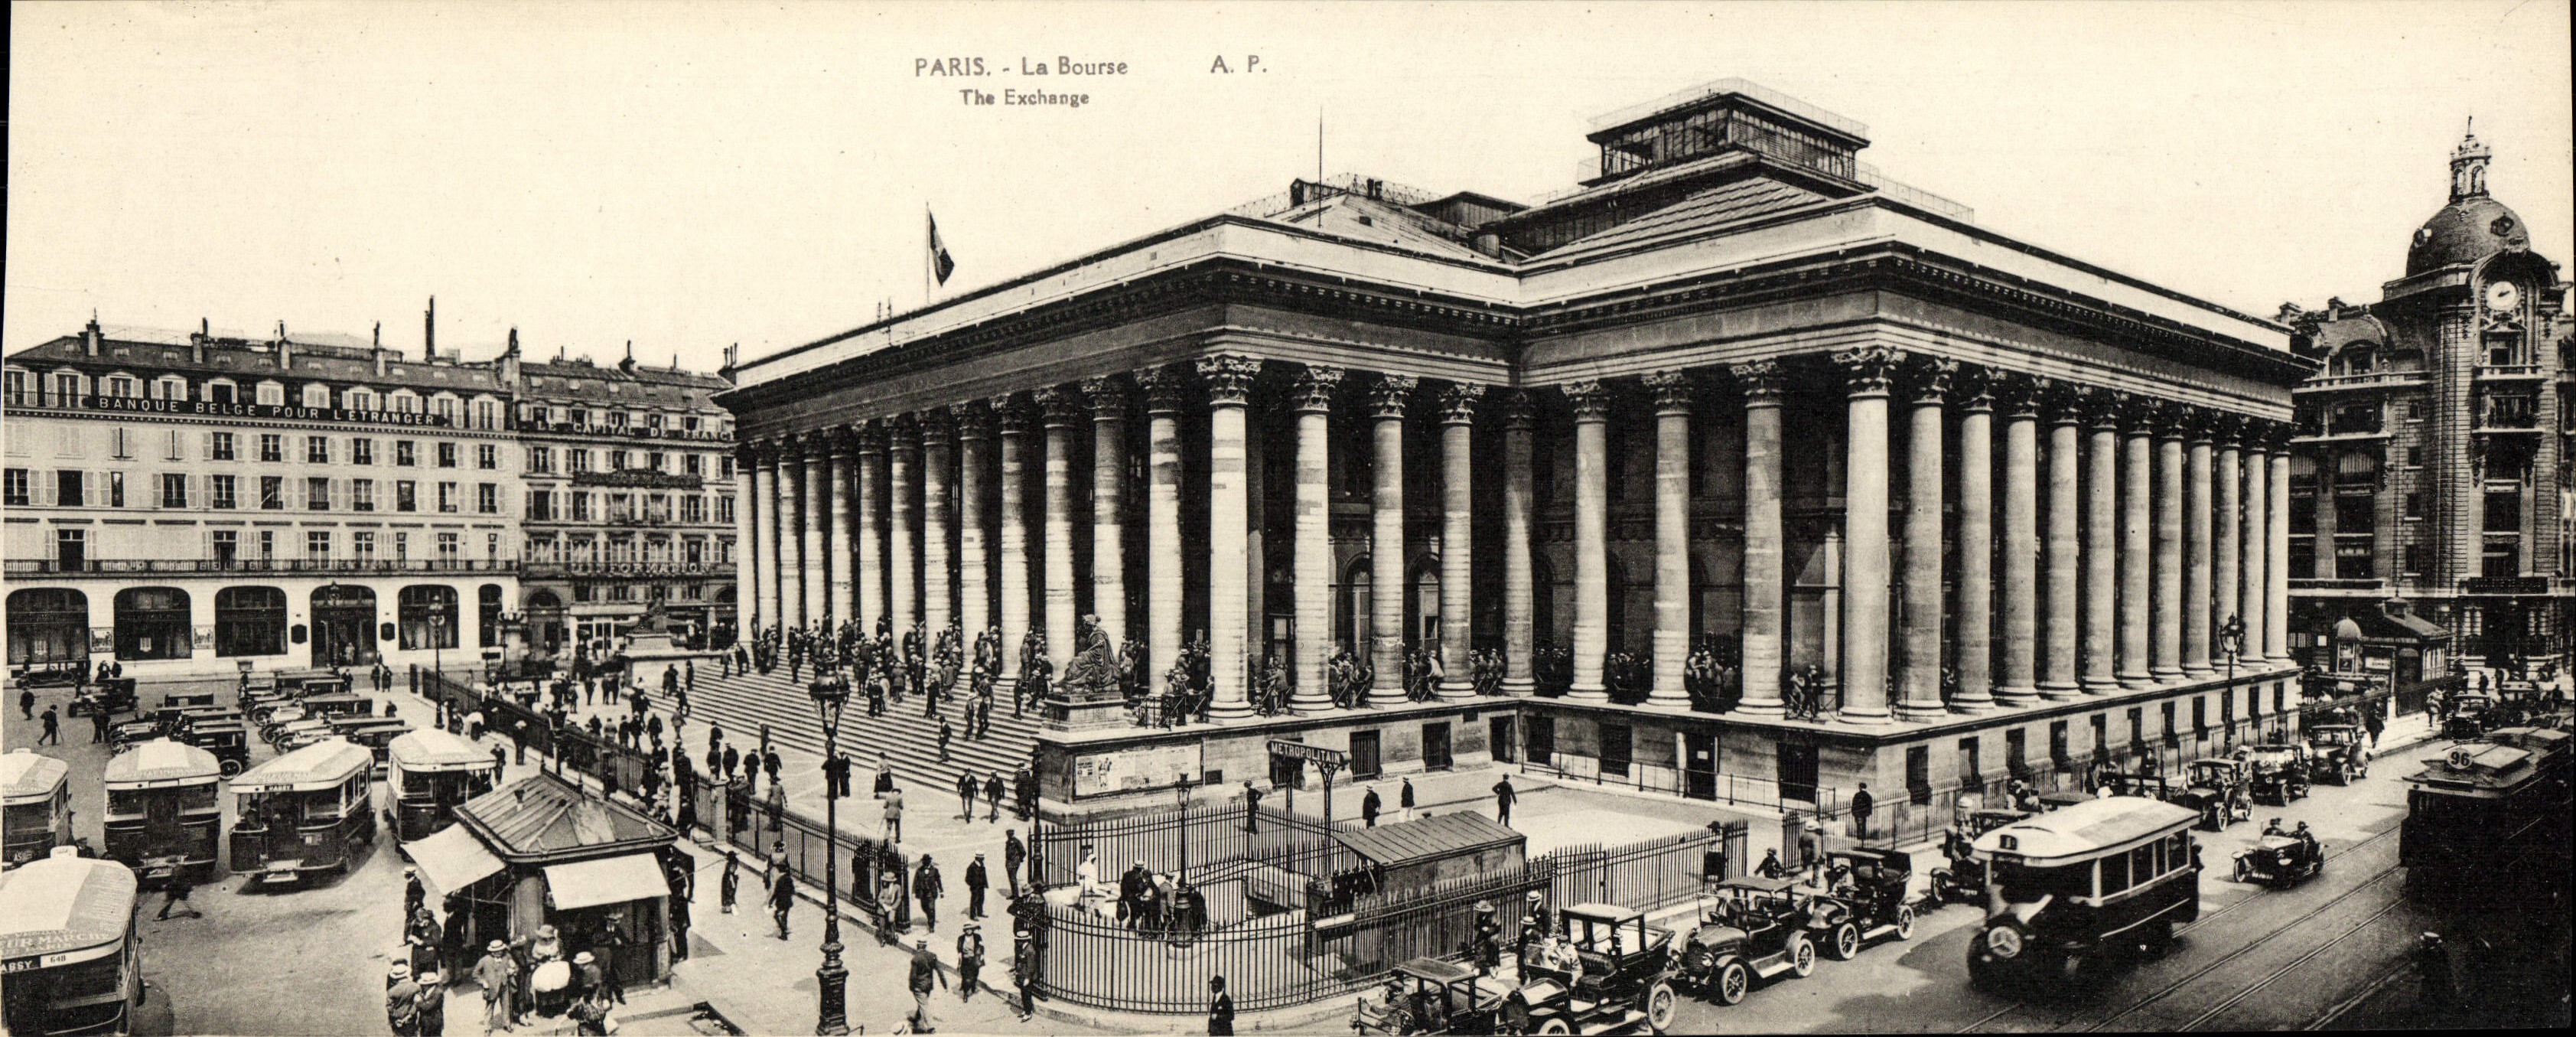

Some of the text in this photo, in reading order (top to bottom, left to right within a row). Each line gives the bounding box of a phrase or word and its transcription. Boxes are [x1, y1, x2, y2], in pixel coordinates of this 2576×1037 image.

[99, 398, 179, 413] BANQUE
[195, 403, 256, 416] BELGE
[272, 406, 319, 419] POUR
[537, 420, 557, 432] LE
[573, 422, 636, 436] CAPITAL
[650, 426, 669, 438] DE
[1272, 742, 1340, 764] METROPOLITAIN
[2451, 751, 2471, 766] 96
[2, 960, 33, 973] ASSY
